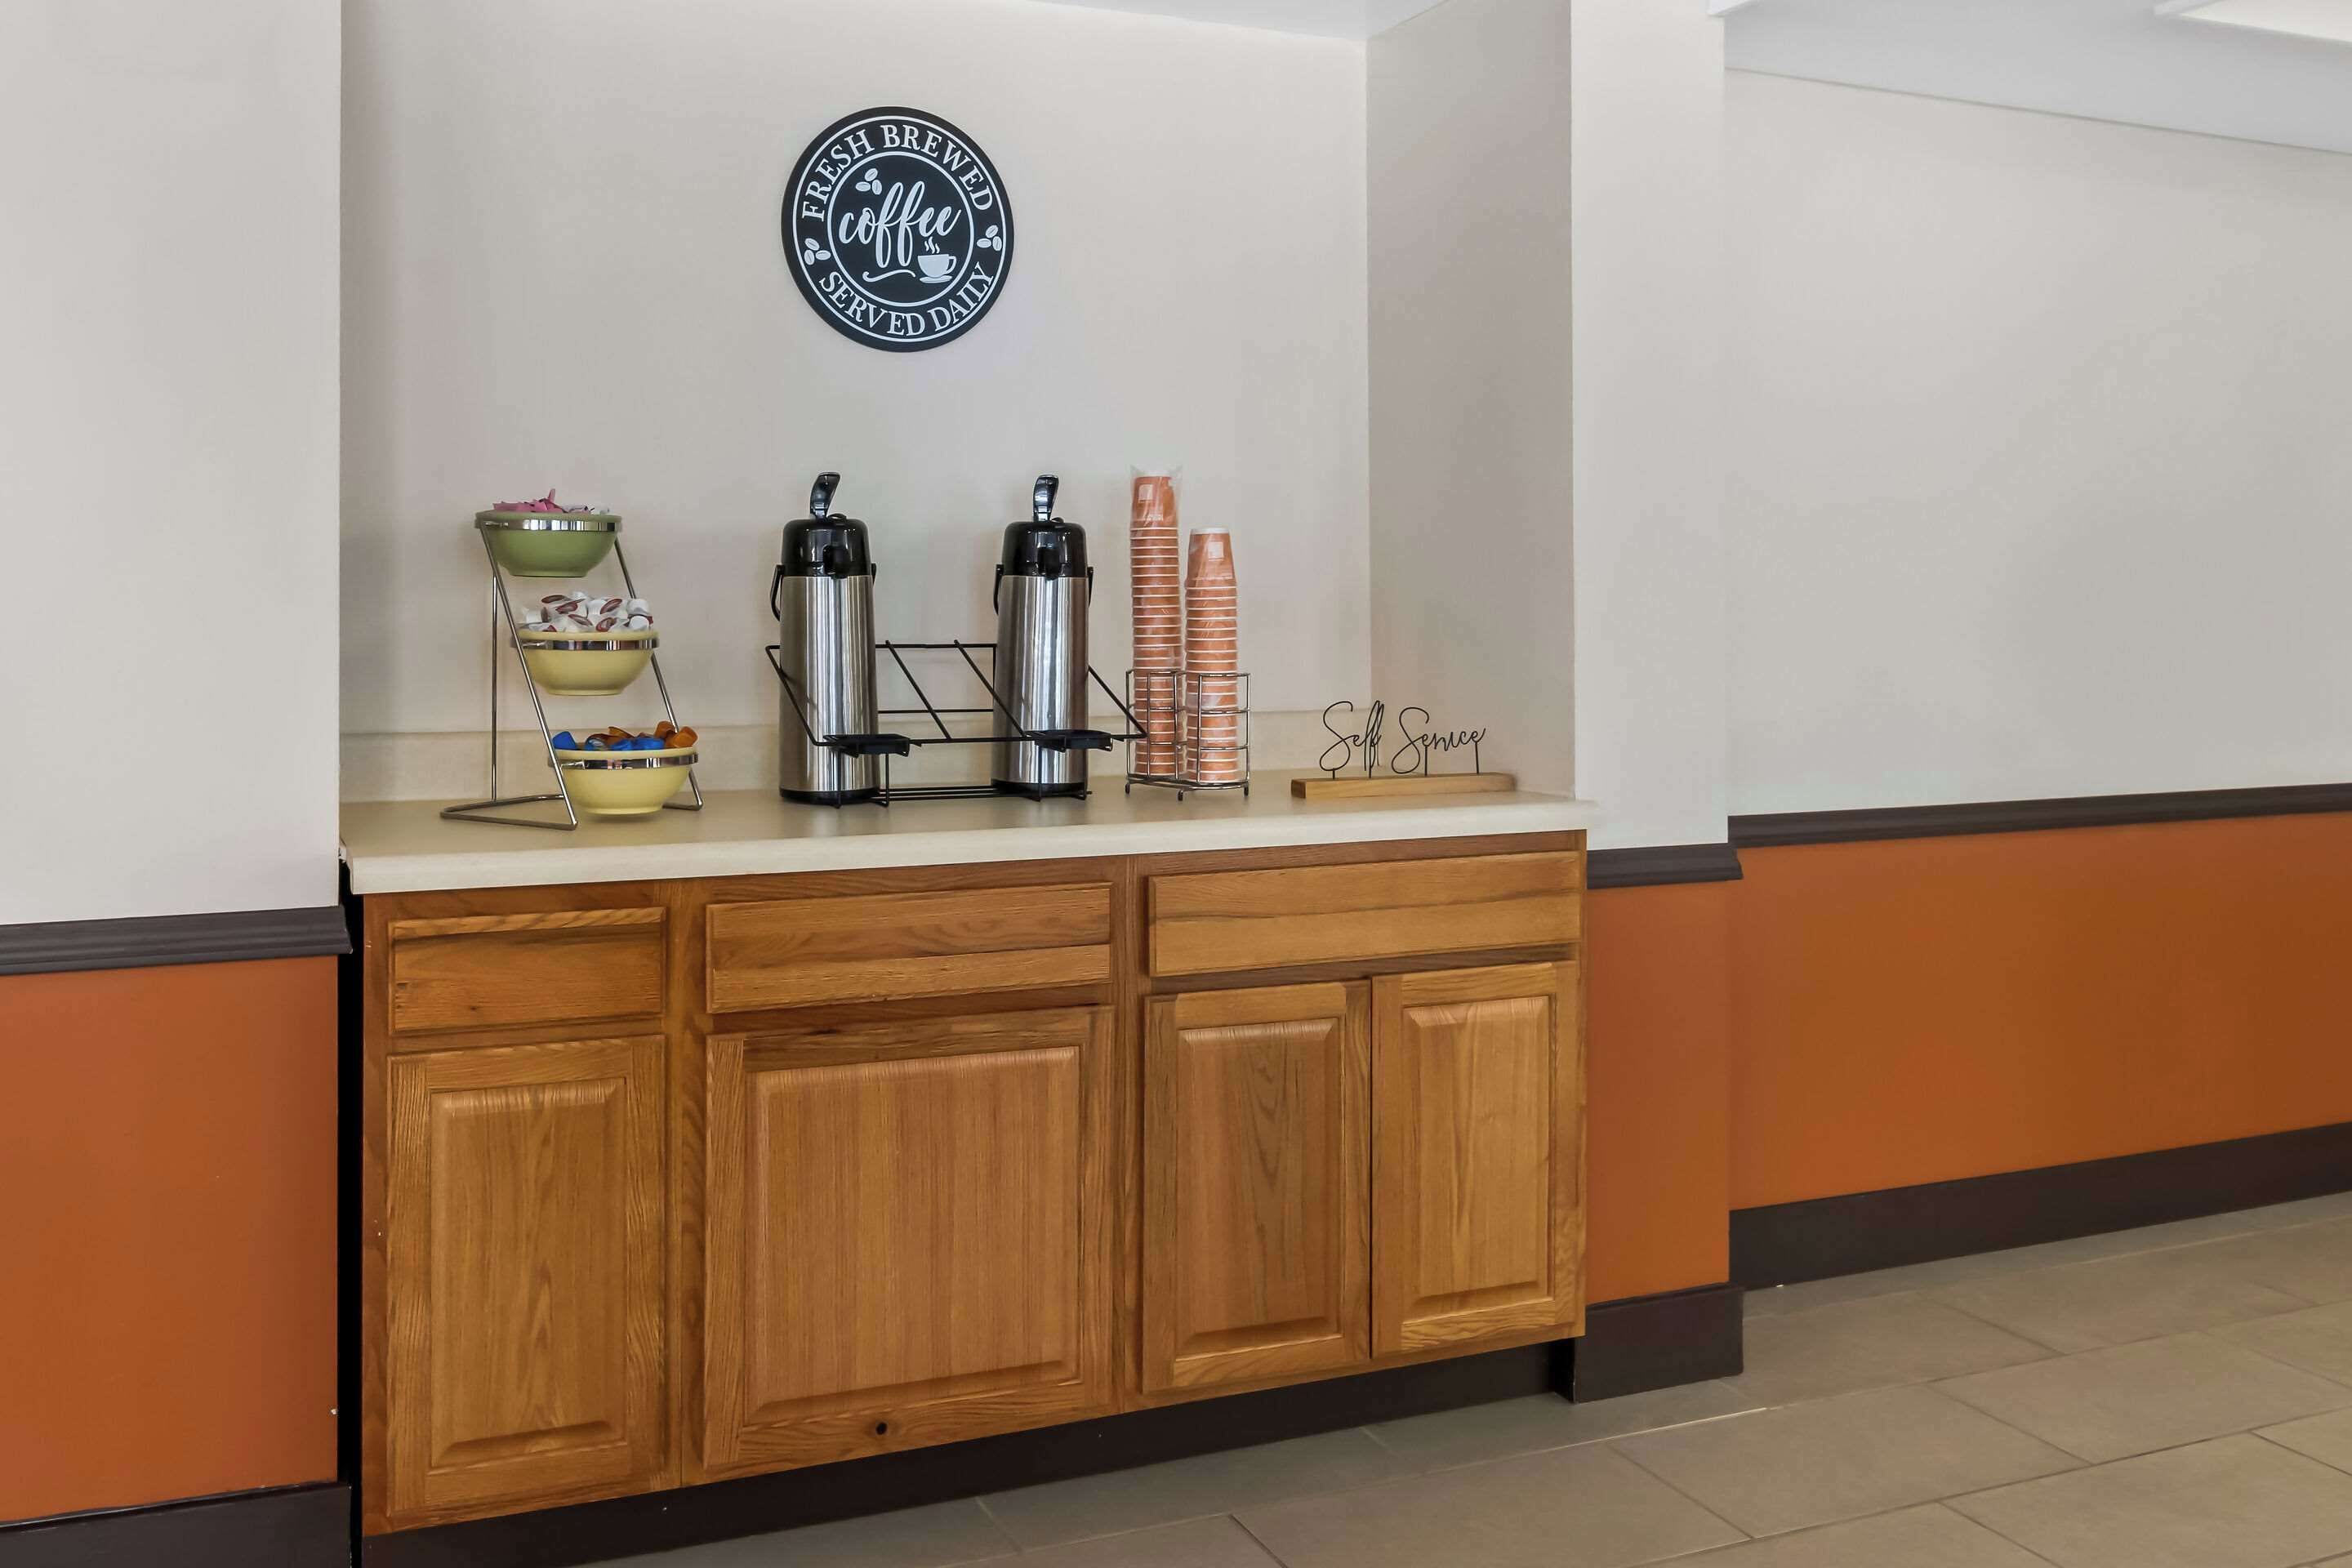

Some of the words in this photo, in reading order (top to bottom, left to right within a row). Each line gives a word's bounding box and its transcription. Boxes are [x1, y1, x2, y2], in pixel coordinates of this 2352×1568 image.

[802, 129, 875, 221] FRESH
[880, 124, 993, 211] BREWED
[838, 180, 962, 269] coffee
[819, 271, 925, 336] SERVED
[928, 261, 995, 332] DAILY
[1319, 700, 1385, 772] Self
